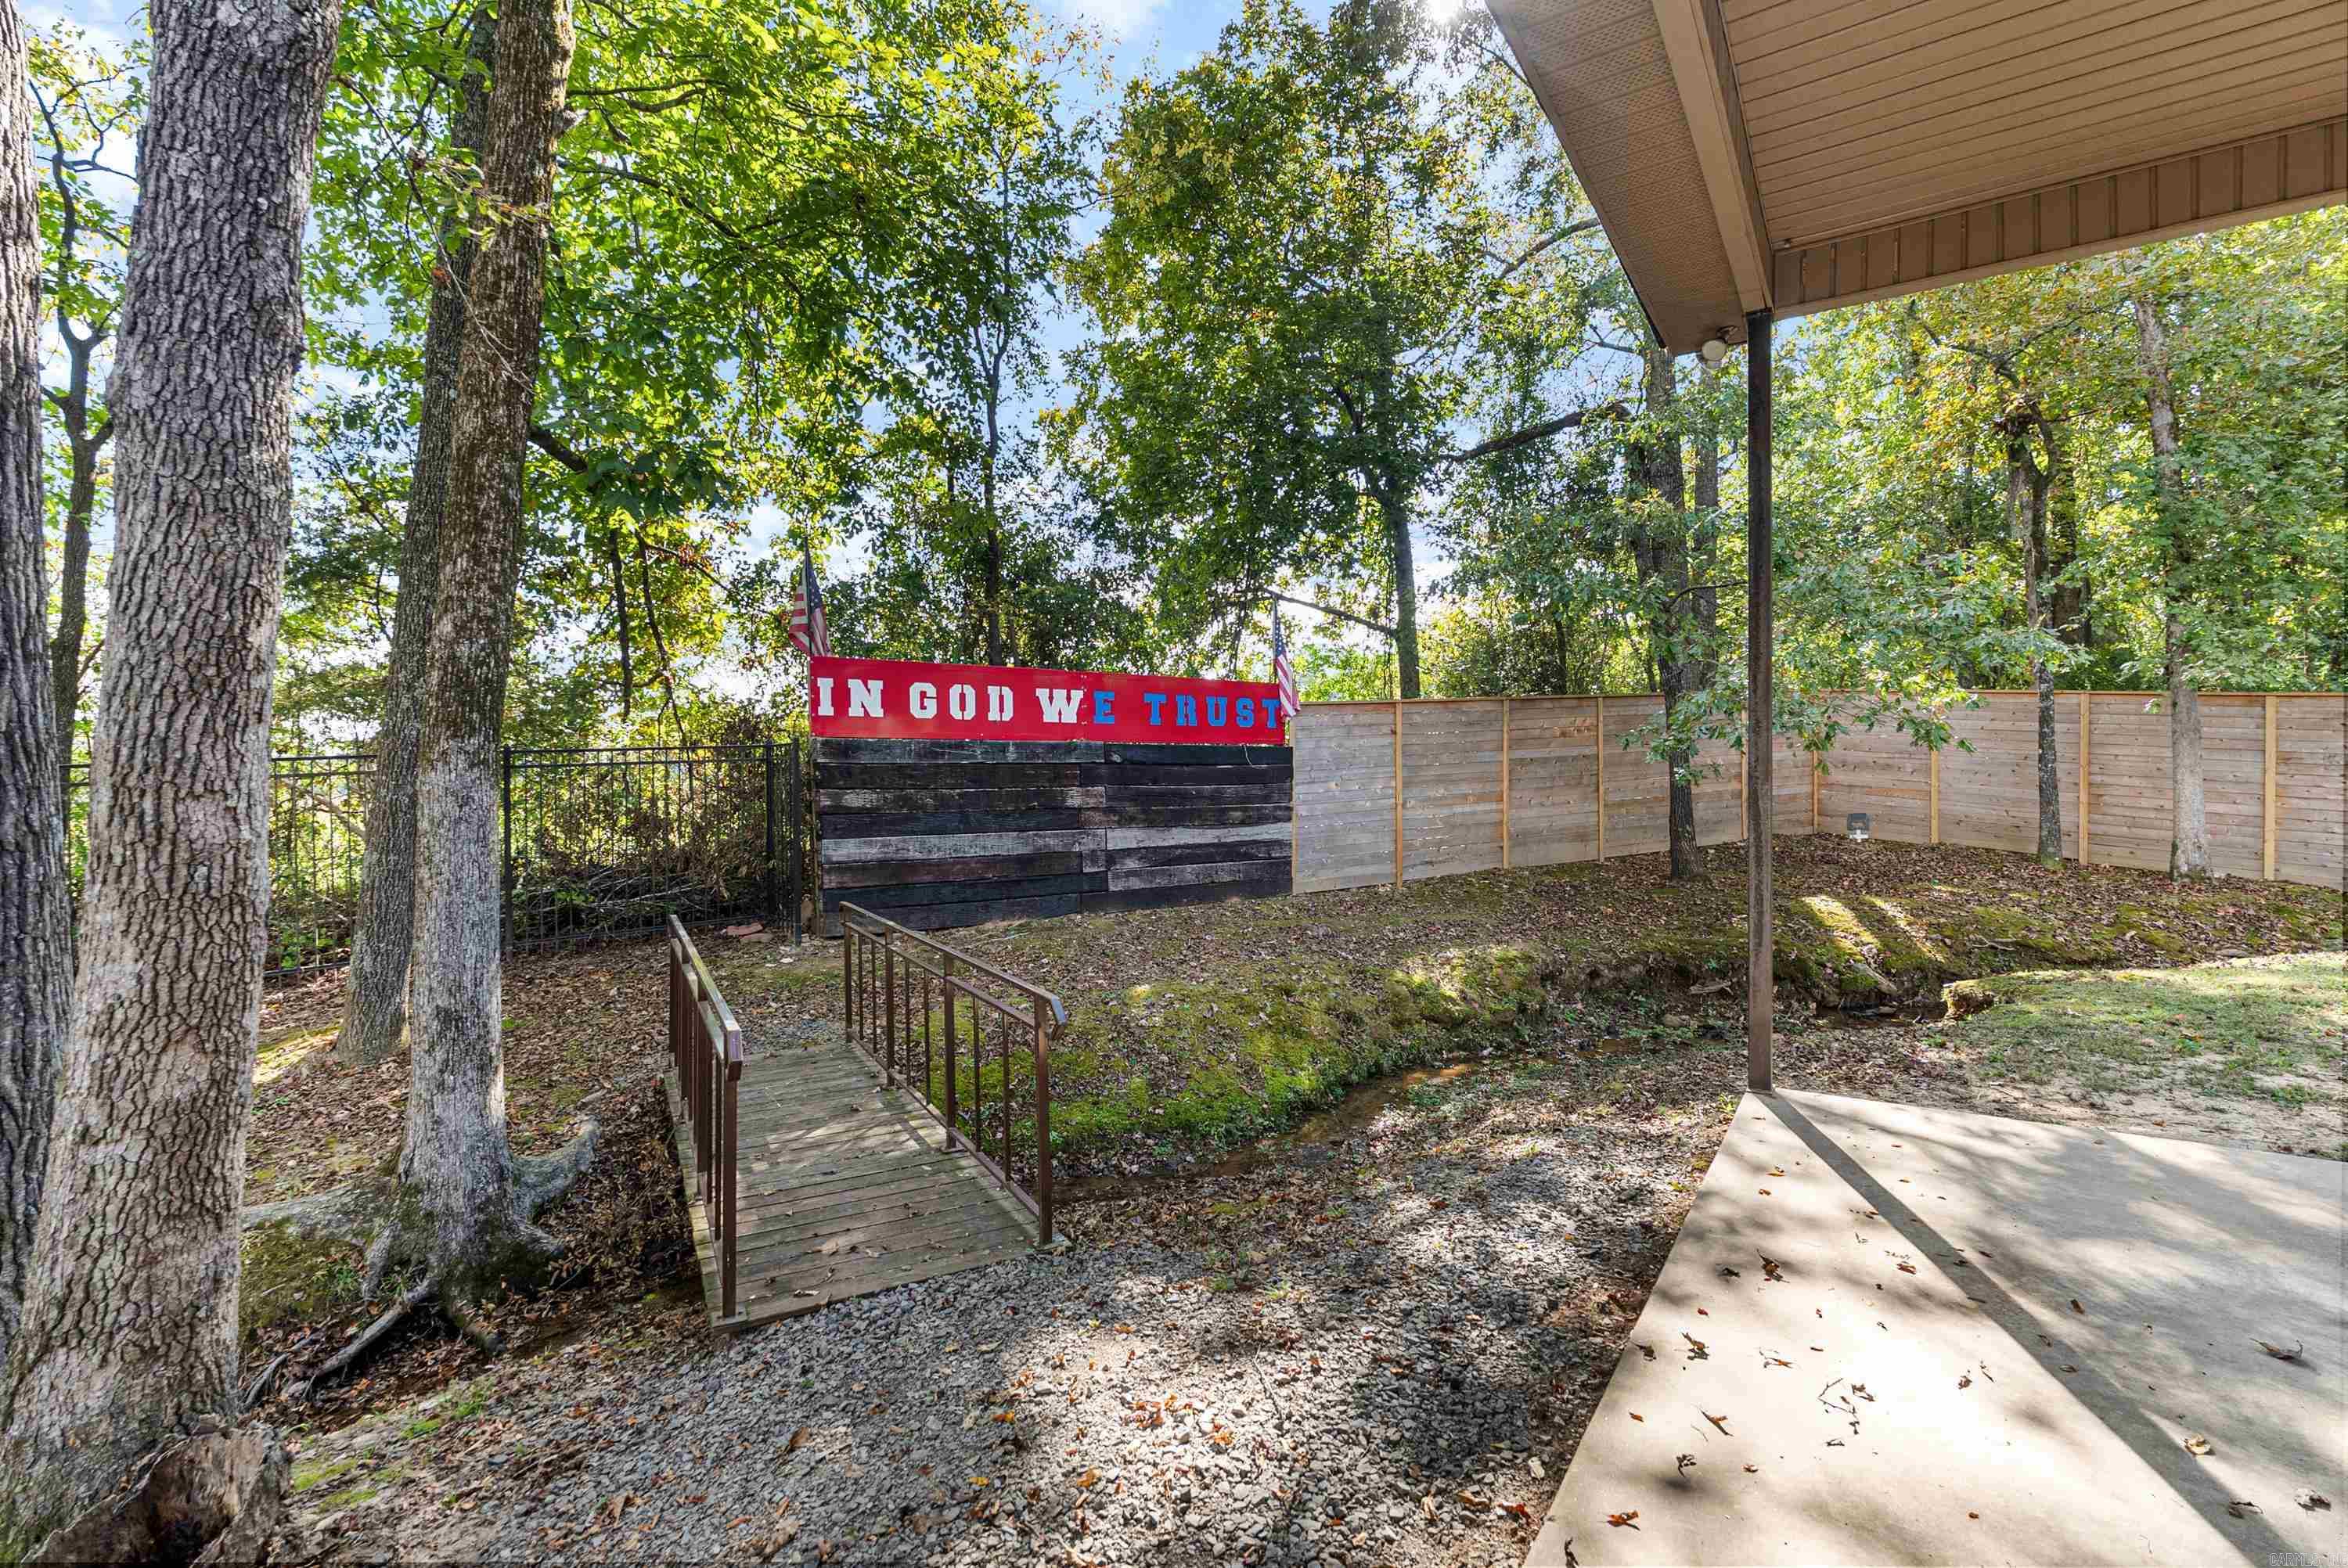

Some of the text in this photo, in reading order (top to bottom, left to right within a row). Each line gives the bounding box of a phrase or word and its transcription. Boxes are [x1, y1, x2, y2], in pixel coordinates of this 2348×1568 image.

[816, 678, 1281, 728] IN GOD WE TRUST
